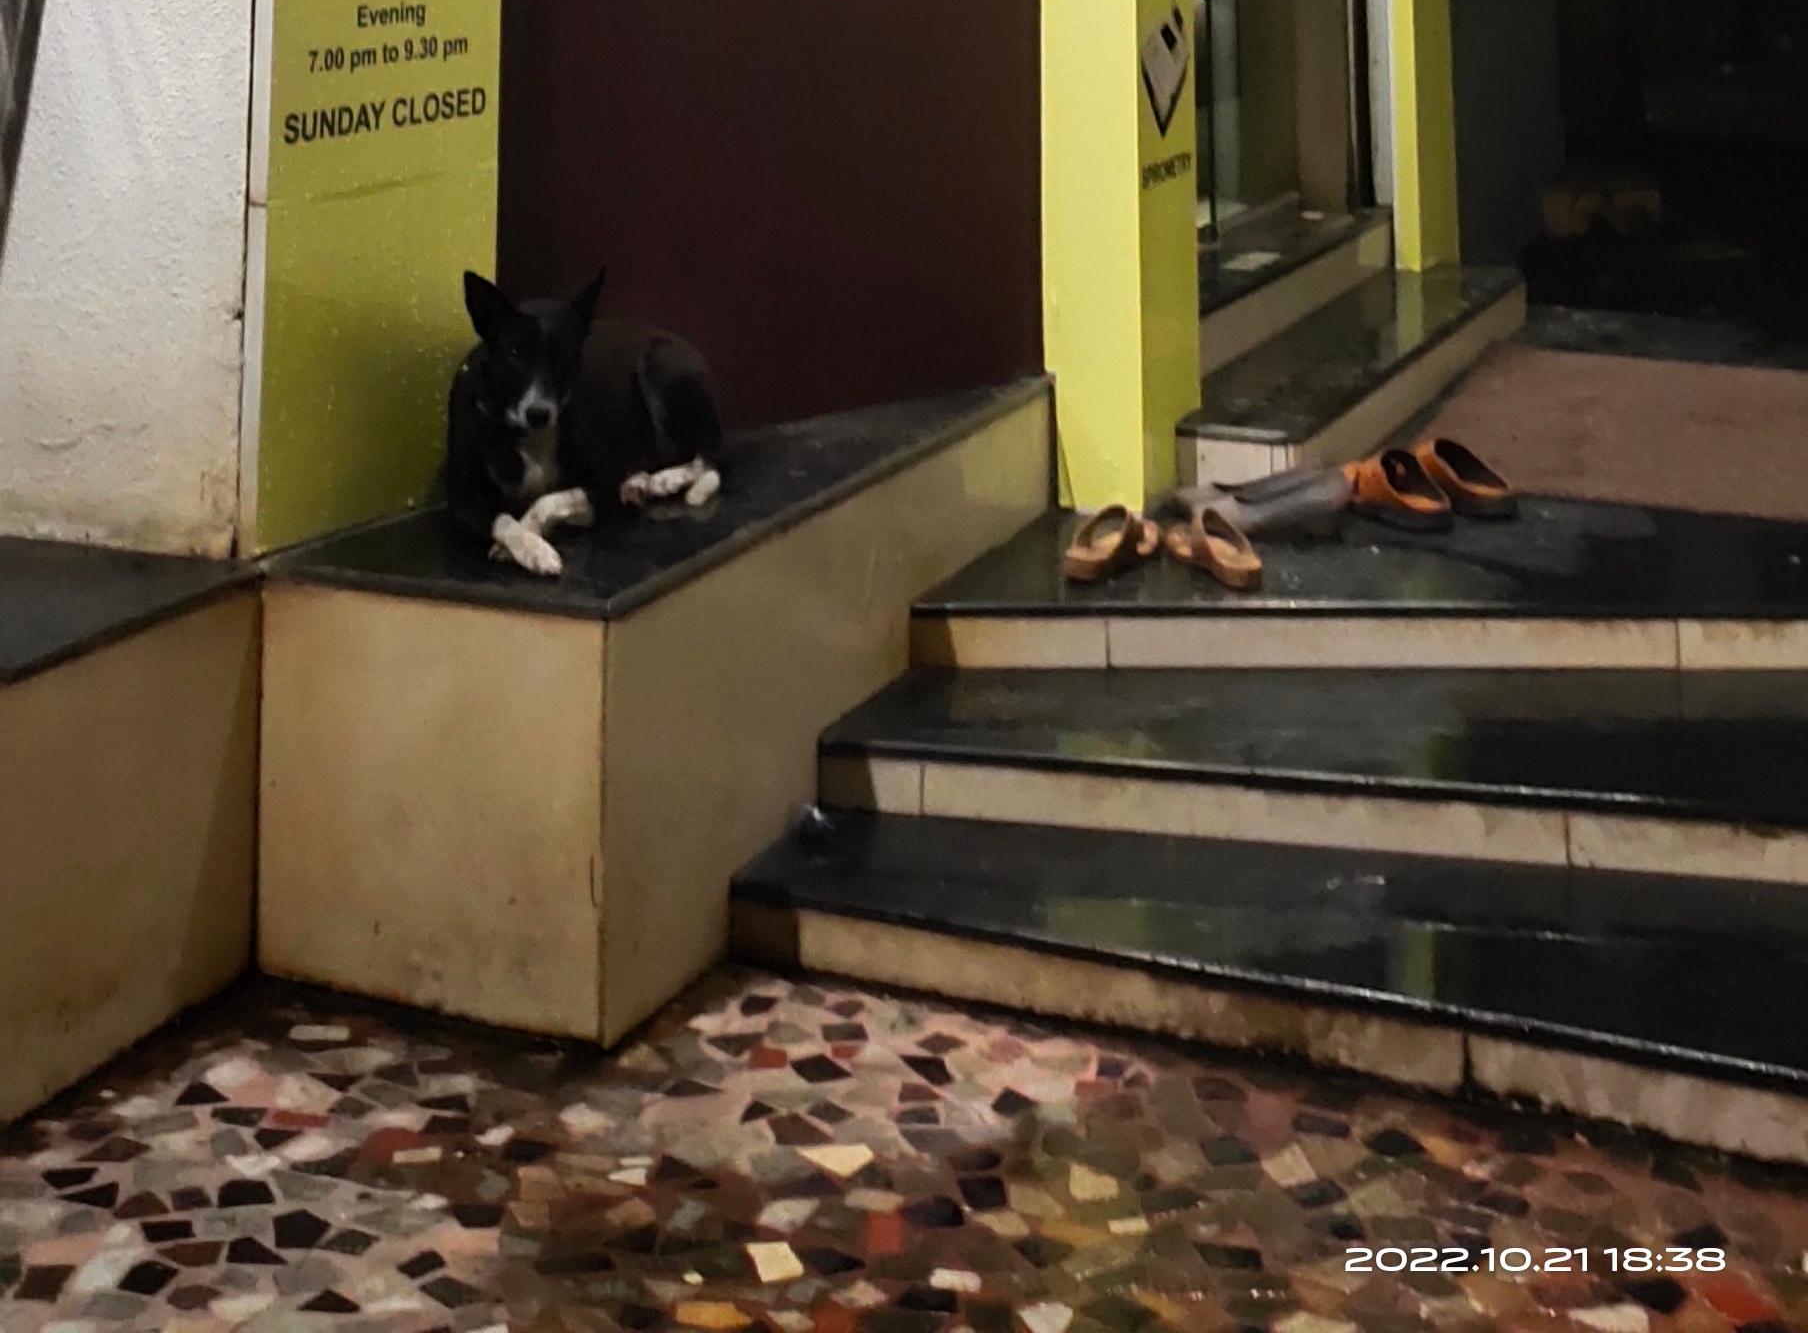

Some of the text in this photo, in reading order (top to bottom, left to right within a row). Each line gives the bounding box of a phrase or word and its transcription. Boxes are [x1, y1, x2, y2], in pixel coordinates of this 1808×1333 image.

[357, 3, 426, 28] Evening
[309, 36, 468, 75] 7.00 pm to 9.30 pm
[284, 87, 486, 145] SUNDAY CLOSED
